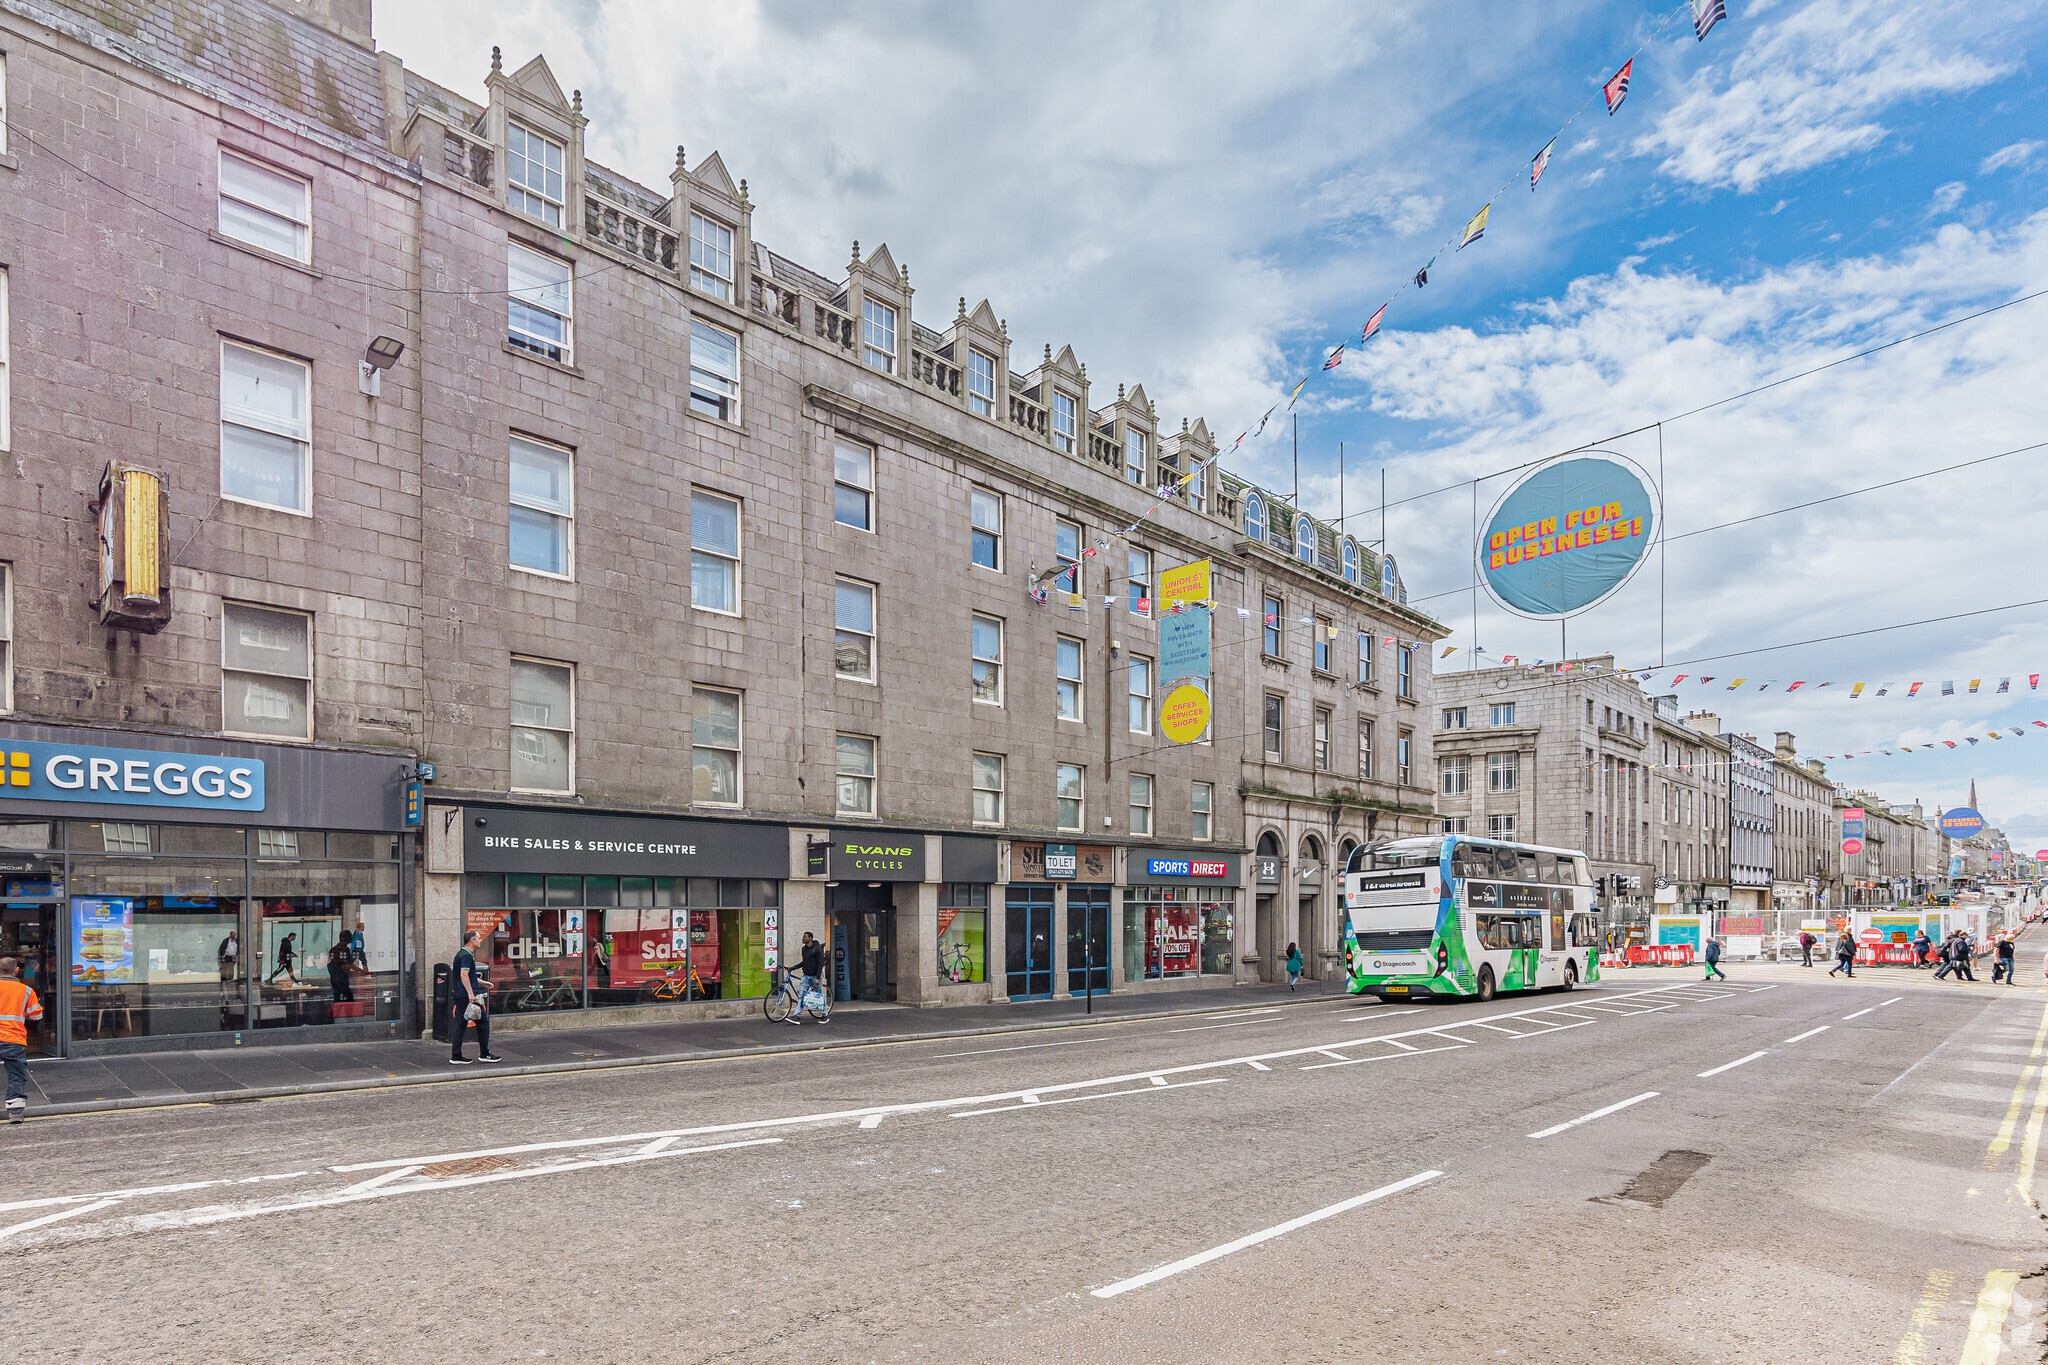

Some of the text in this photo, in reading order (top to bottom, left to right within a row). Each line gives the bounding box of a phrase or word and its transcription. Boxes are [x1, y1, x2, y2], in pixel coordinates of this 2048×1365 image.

[1490, 501, 1622, 551] OPEN FOR
[1490, 517, 1642, 570] BUSINESS!
[1165, 572, 1203, 589] UNION ST
[1165, 583, 1203, 597] CENTRAL
[1167, 630, 1203, 641] PAVEMENTS
[1170, 647, 1200, 658] SCOTTISH
[1172, 701, 1197, 711] CAFES
[1166, 708, 1204, 720] SERVICES
[1172, 718, 1198, 728] SHOPS
[45, 754, 253, 799] GREGGS
[484, 836, 697, 855] BIKE SALES & SERVICE CENTRE
[845, 844, 913, 856] EVANS
[1022, 846, 1045, 863] SH
[855, 860, 903, 869] CYCLES
[1048, 857, 1073, 867] TO LET
[1153, 861, 1225, 875] SPORTS DIRECT
[1164, 925, 1198, 940] ALE
[507, 937, 560, 959] dhb
[1178, 944, 1190, 952] OFF
